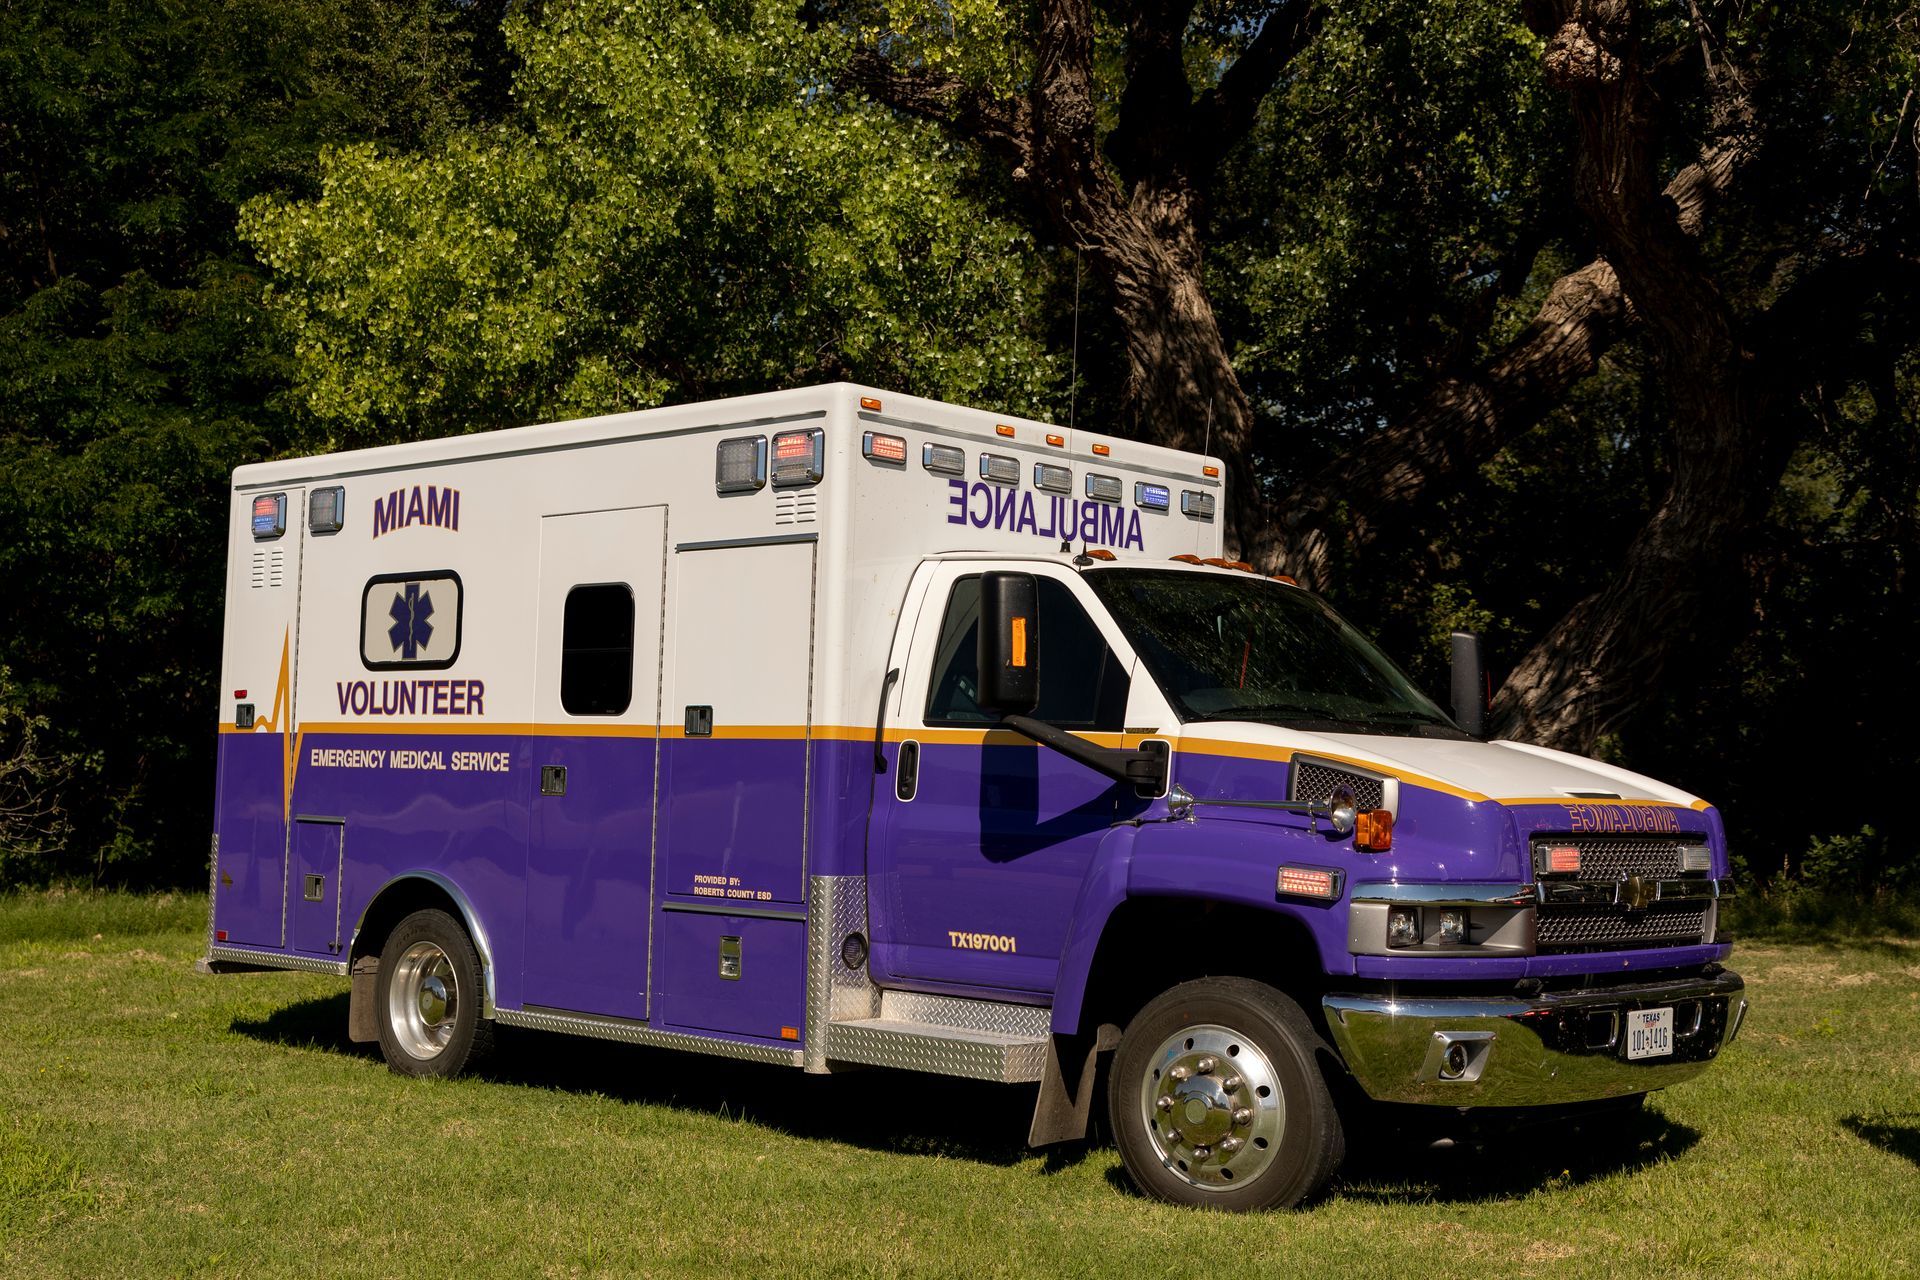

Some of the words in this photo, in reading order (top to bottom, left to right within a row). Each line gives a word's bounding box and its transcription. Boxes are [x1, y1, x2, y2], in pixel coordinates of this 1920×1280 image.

[373, 485, 460, 540] MIAMI
[337, 680, 485, 715] VOLUNTEER
[311, 749, 386, 768] EMERGENCY
[390, 750, 446, 770] MEDICAL
[451, 752, 509, 771] SERVICE
[694, 874, 727, 885] PROVIDED
[729, 877, 740, 886] BY:
[694, 886, 725, 897] ROBERTS
[727, 889, 755, 899] COUNTY
[757, 891, 772, 900] ESD
[948, 931, 1016, 953] TX197001
[1642, 1012, 1660, 1023] TEXAS
